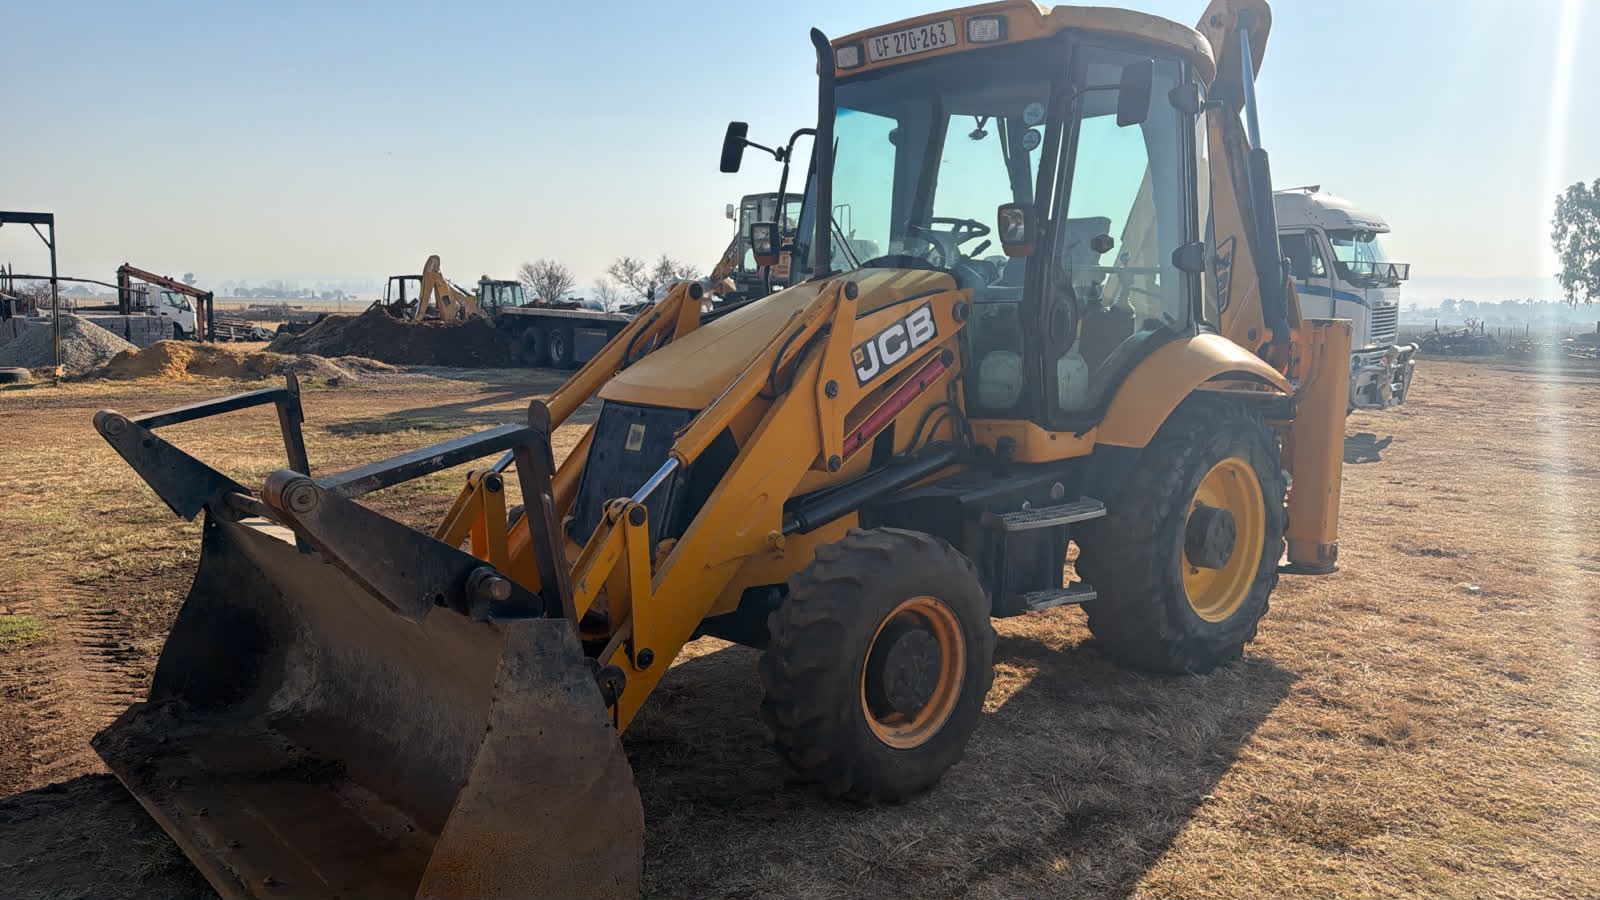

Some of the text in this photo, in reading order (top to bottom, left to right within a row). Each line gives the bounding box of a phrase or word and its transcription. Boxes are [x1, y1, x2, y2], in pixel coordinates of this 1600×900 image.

[875, 23, 946, 57] CF 270-263
[857, 306, 935, 382] JCB
